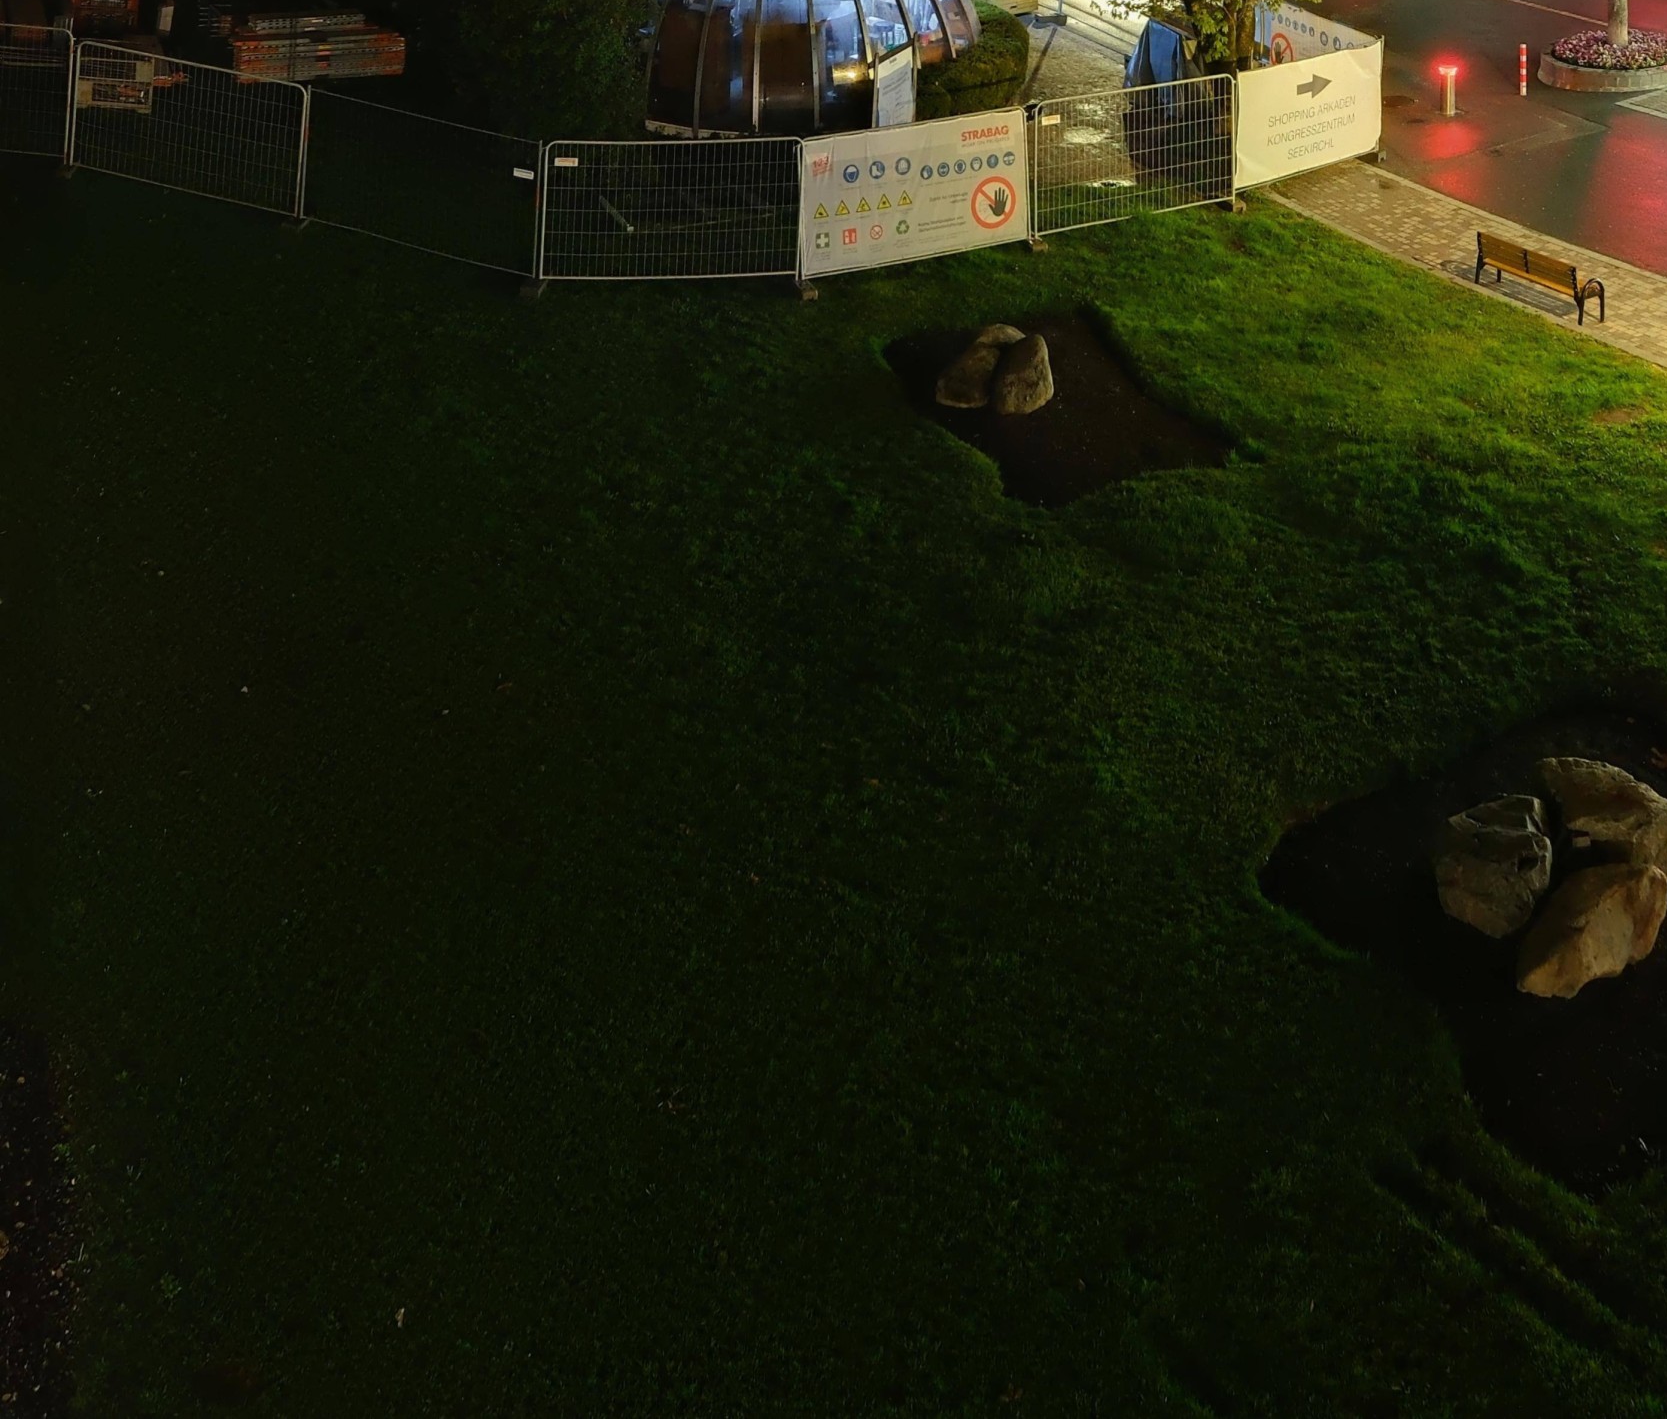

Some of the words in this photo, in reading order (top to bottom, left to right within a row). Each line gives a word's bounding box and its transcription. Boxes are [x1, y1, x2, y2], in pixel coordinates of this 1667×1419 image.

[1268, 107, 1316, 128] SHOPPING
[1317, 95, 1356, 116] ARKADEN
[961, 125, 1009, 141] STRABAG
[1267, 113, 1355, 147] KONGRESSZENTRUM
[1287, 138, 1334, 160] SEEKIRCHL
